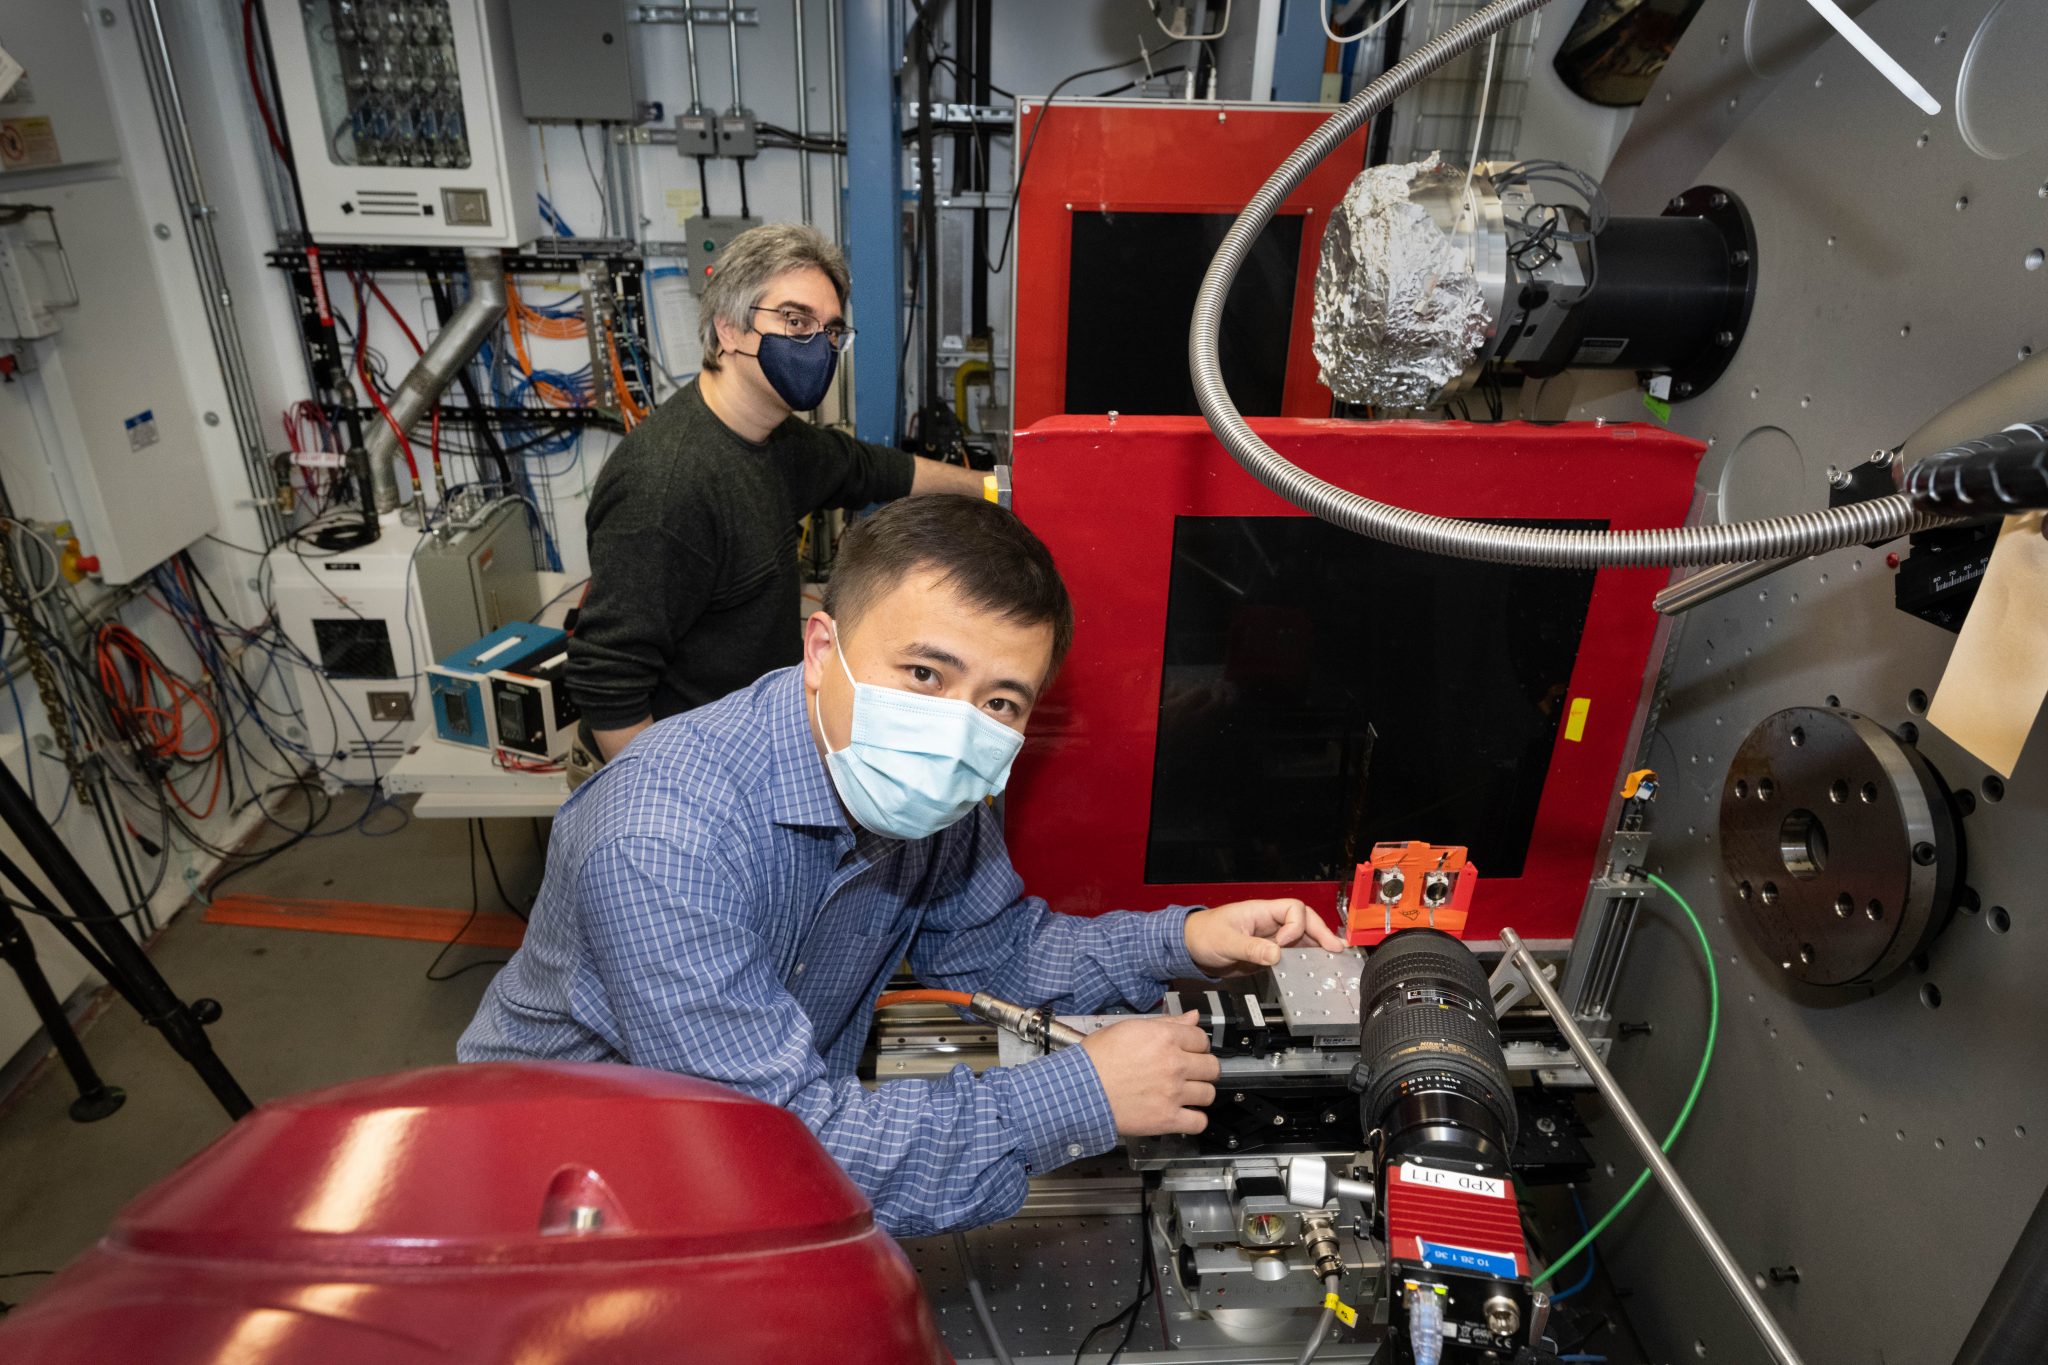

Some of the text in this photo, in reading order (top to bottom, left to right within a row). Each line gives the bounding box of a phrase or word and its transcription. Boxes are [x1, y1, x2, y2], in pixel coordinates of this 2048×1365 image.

[1412, 1169, 1496, 1193] XPD JT1
[1434, 1250, 1448, 1258] 36
[1452, 1253, 1457, 1261] 1
[1461, 1256, 1475, 1265] 28
